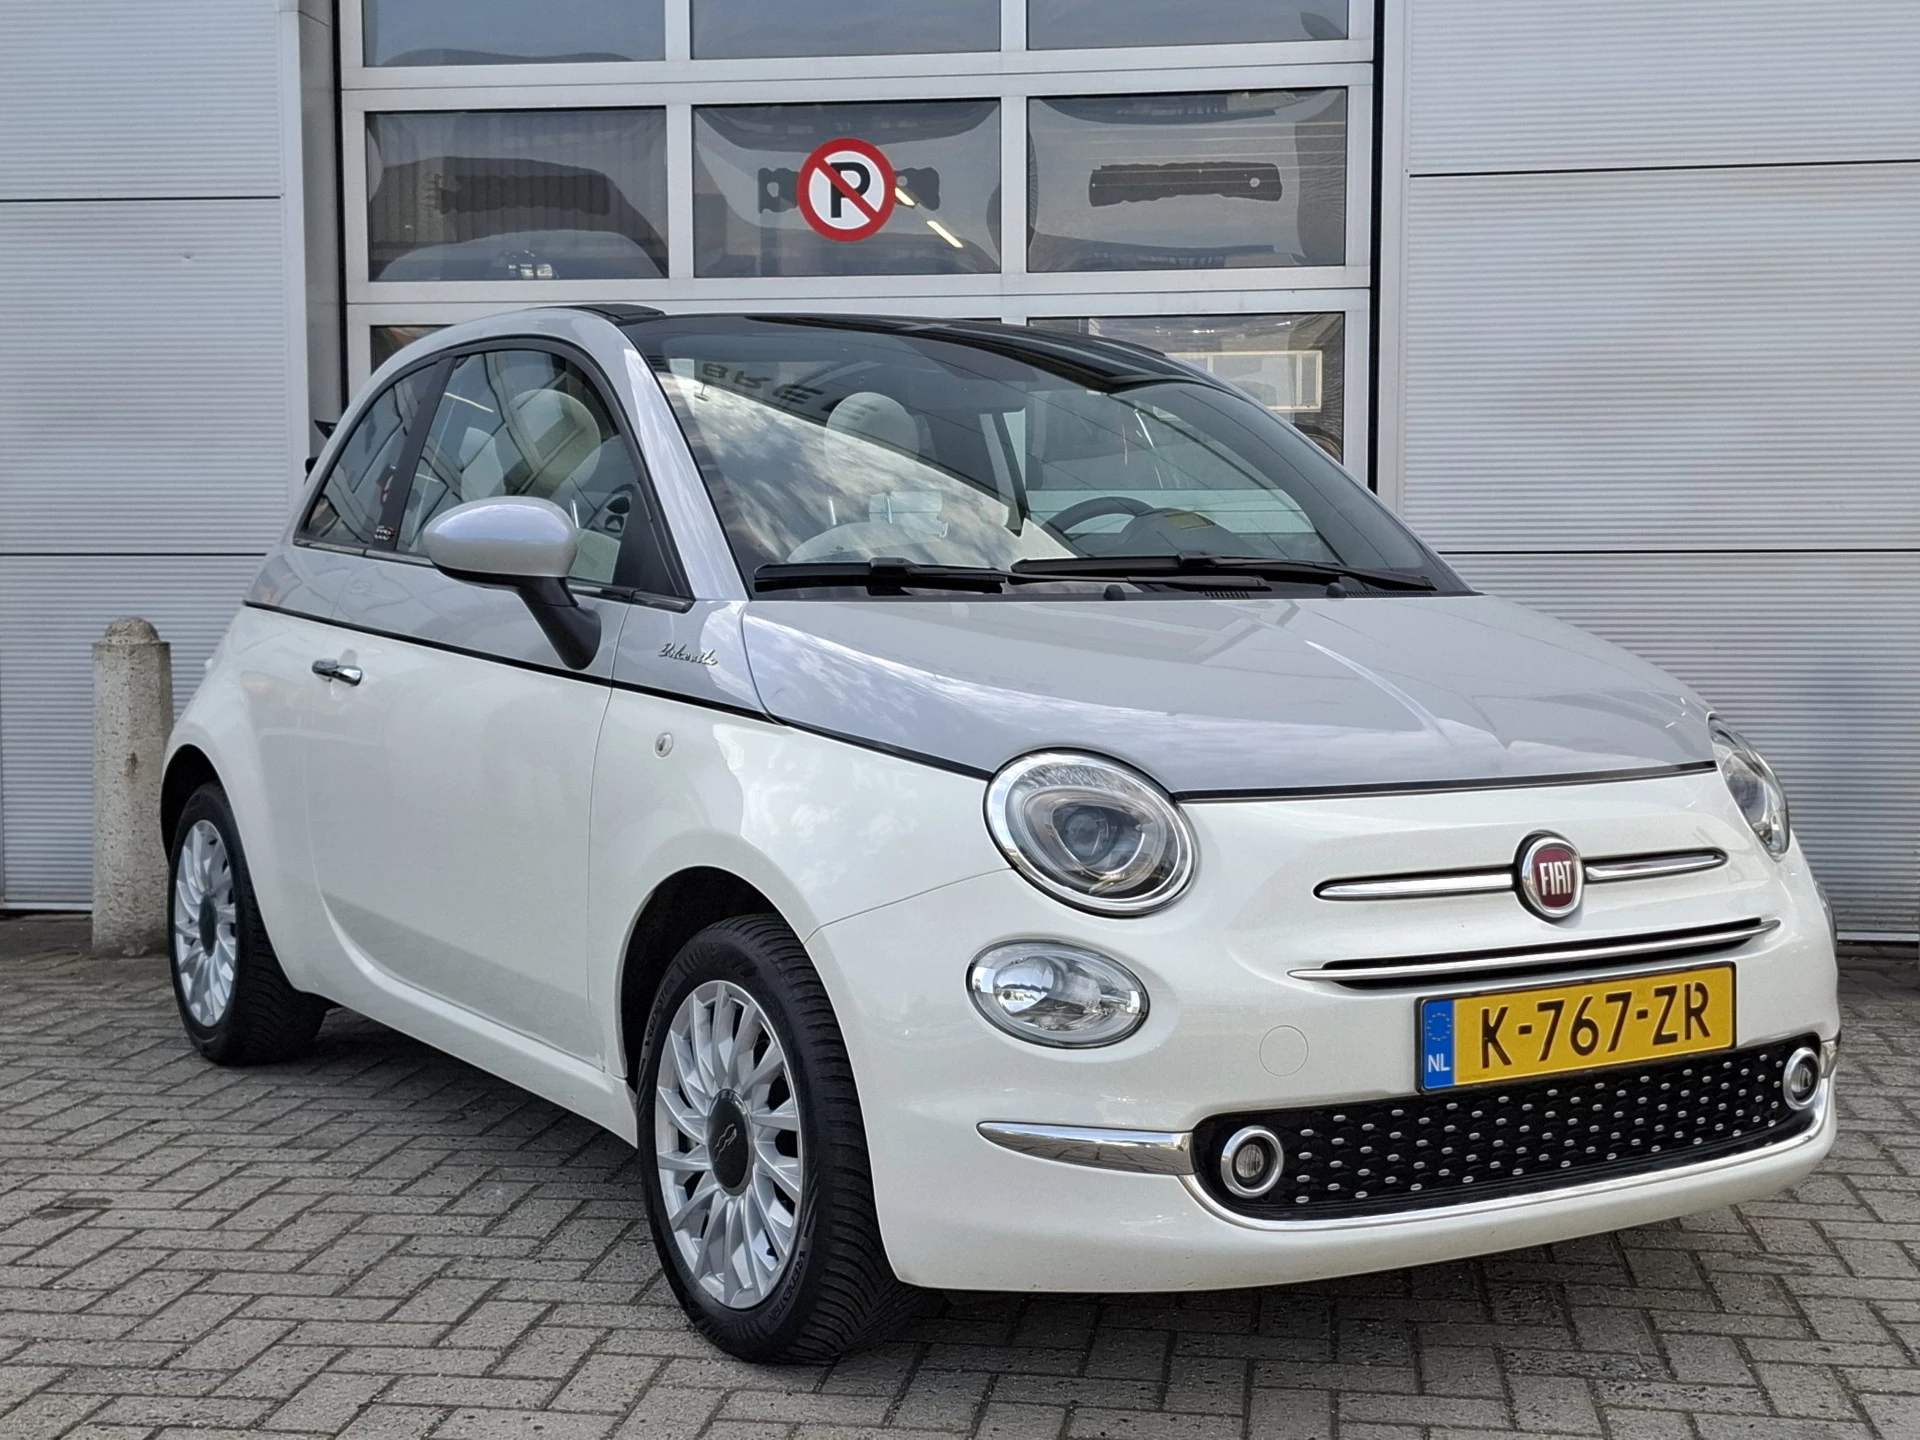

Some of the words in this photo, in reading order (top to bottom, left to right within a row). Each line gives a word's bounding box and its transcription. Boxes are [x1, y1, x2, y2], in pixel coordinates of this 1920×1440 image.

[829, 162, 871, 218] P
[1538, 860, 1572, 896] FIAT
[1481, 981, 1711, 1069] K-767-ZR
[1428, 1053, 1450, 1073] NL
